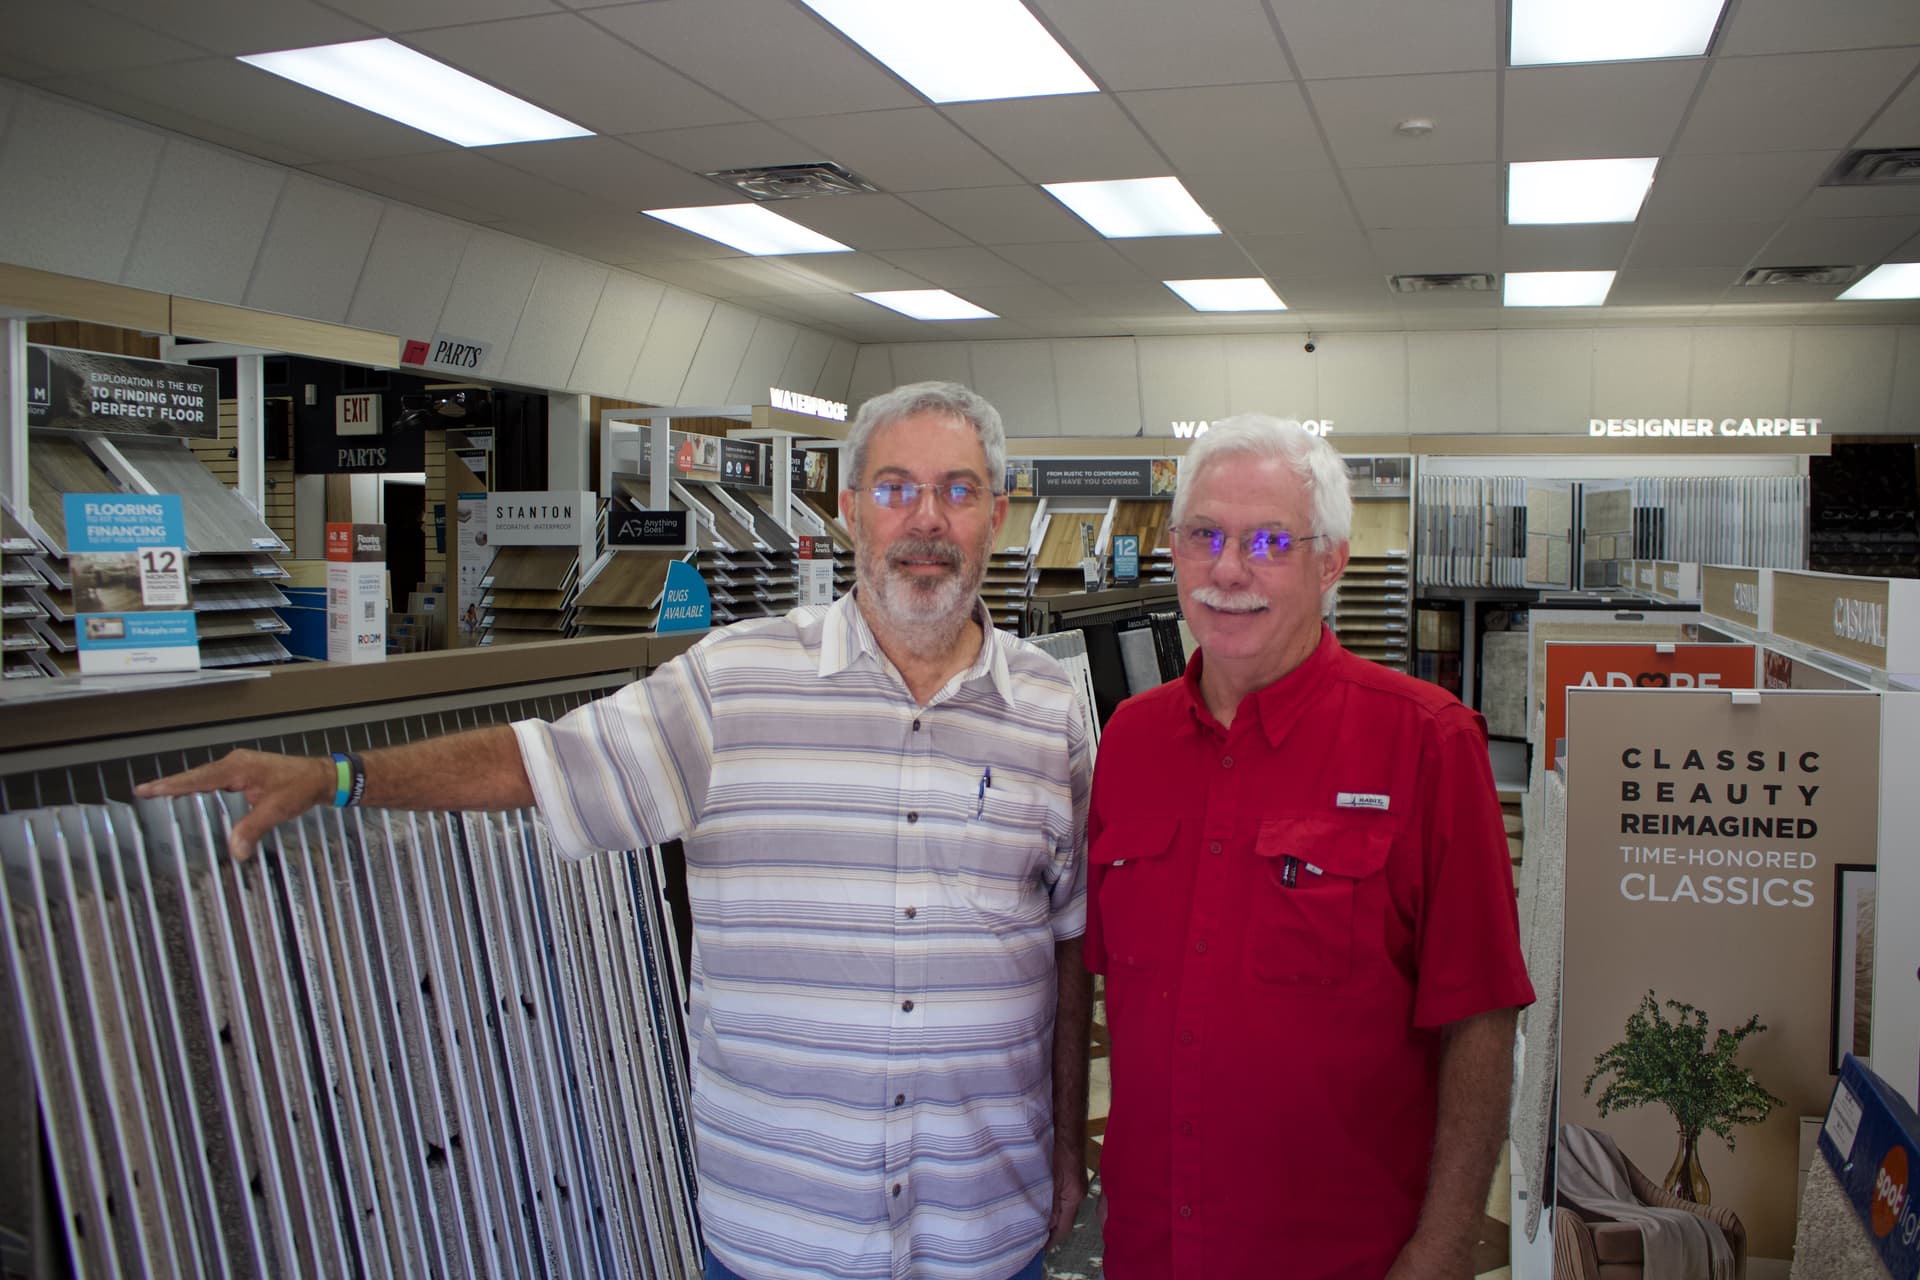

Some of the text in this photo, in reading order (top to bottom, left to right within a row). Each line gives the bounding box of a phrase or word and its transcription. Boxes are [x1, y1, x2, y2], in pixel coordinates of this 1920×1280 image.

[433, 340, 482, 368] PARTS
[91, 372, 203, 393] EXPLORATION IS THE KEY
[92, 386, 204, 408] TO FINDING YOUR
[769, 387, 848, 421] WATERPROOF
[91, 403, 204, 423] PERFECT FLOOR
[343, 397, 370, 424] EXIT
[1589, 418, 1822, 437] DESIGNER CARPET
[337, 447, 387, 467] PARTS
[85, 503, 163, 516] FLOORING
[496, 506, 571, 519] STANTON
[87, 526, 167, 537] FINANCING
[644, 518, 678, 528] Anything
[1115, 538, 1137, 556] 12
[141, 550, 178, 573] 12
[667, 589, 689, 602] RUGS
[663, 604, 705, 619] AVAILABLE
[1833, 597, 1885, 648] CASUAL
[1621, 748, 1819, 773] CLASSIC
[1621, 781, 1820, 806] BEAUTY
[1621, 813, 1818, 839] REIMAGINED
[1619, 846, 1817, 869] TIME-HONORED
[1620, 872, 1815, 908] CLASSICS
